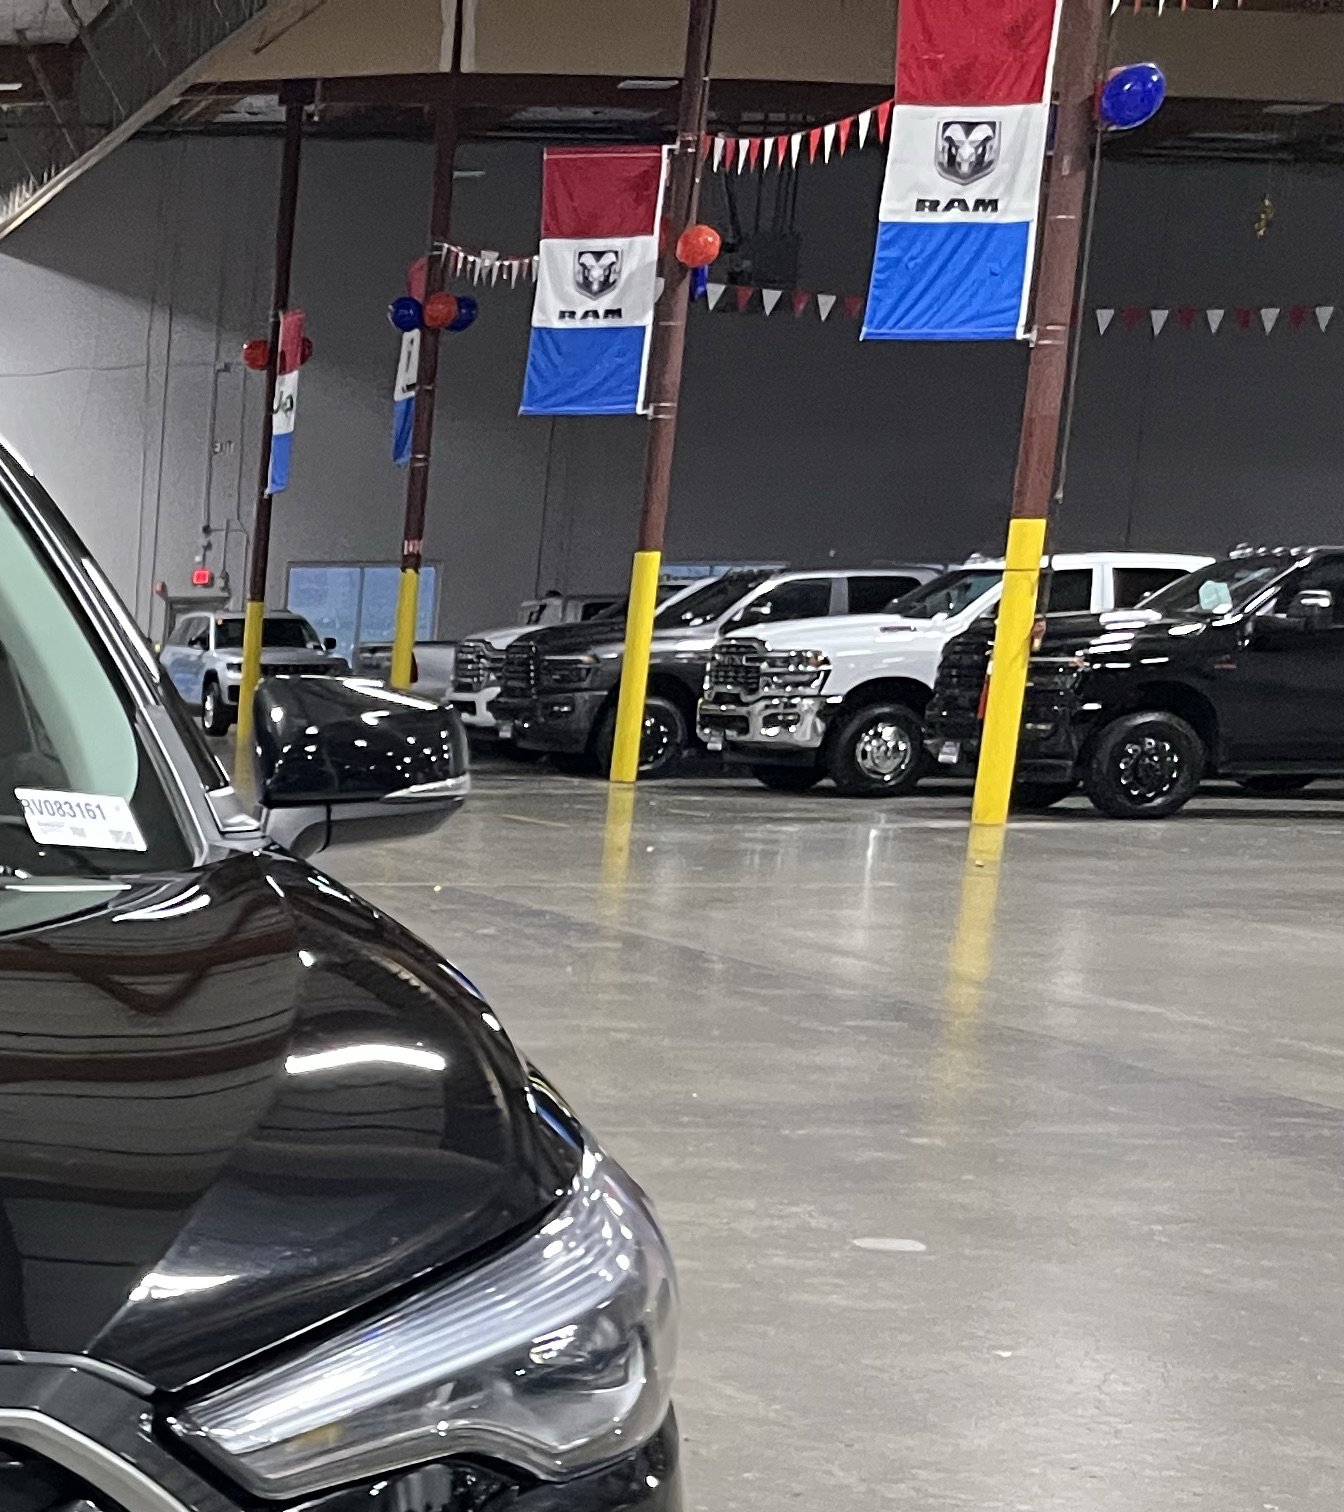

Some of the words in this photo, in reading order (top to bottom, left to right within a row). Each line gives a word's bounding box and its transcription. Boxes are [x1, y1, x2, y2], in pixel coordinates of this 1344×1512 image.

[914, 198, 1000, 213] RAM
[558, 308, 623, 320] RAM
[21, 798, 107, 821] RV083161
